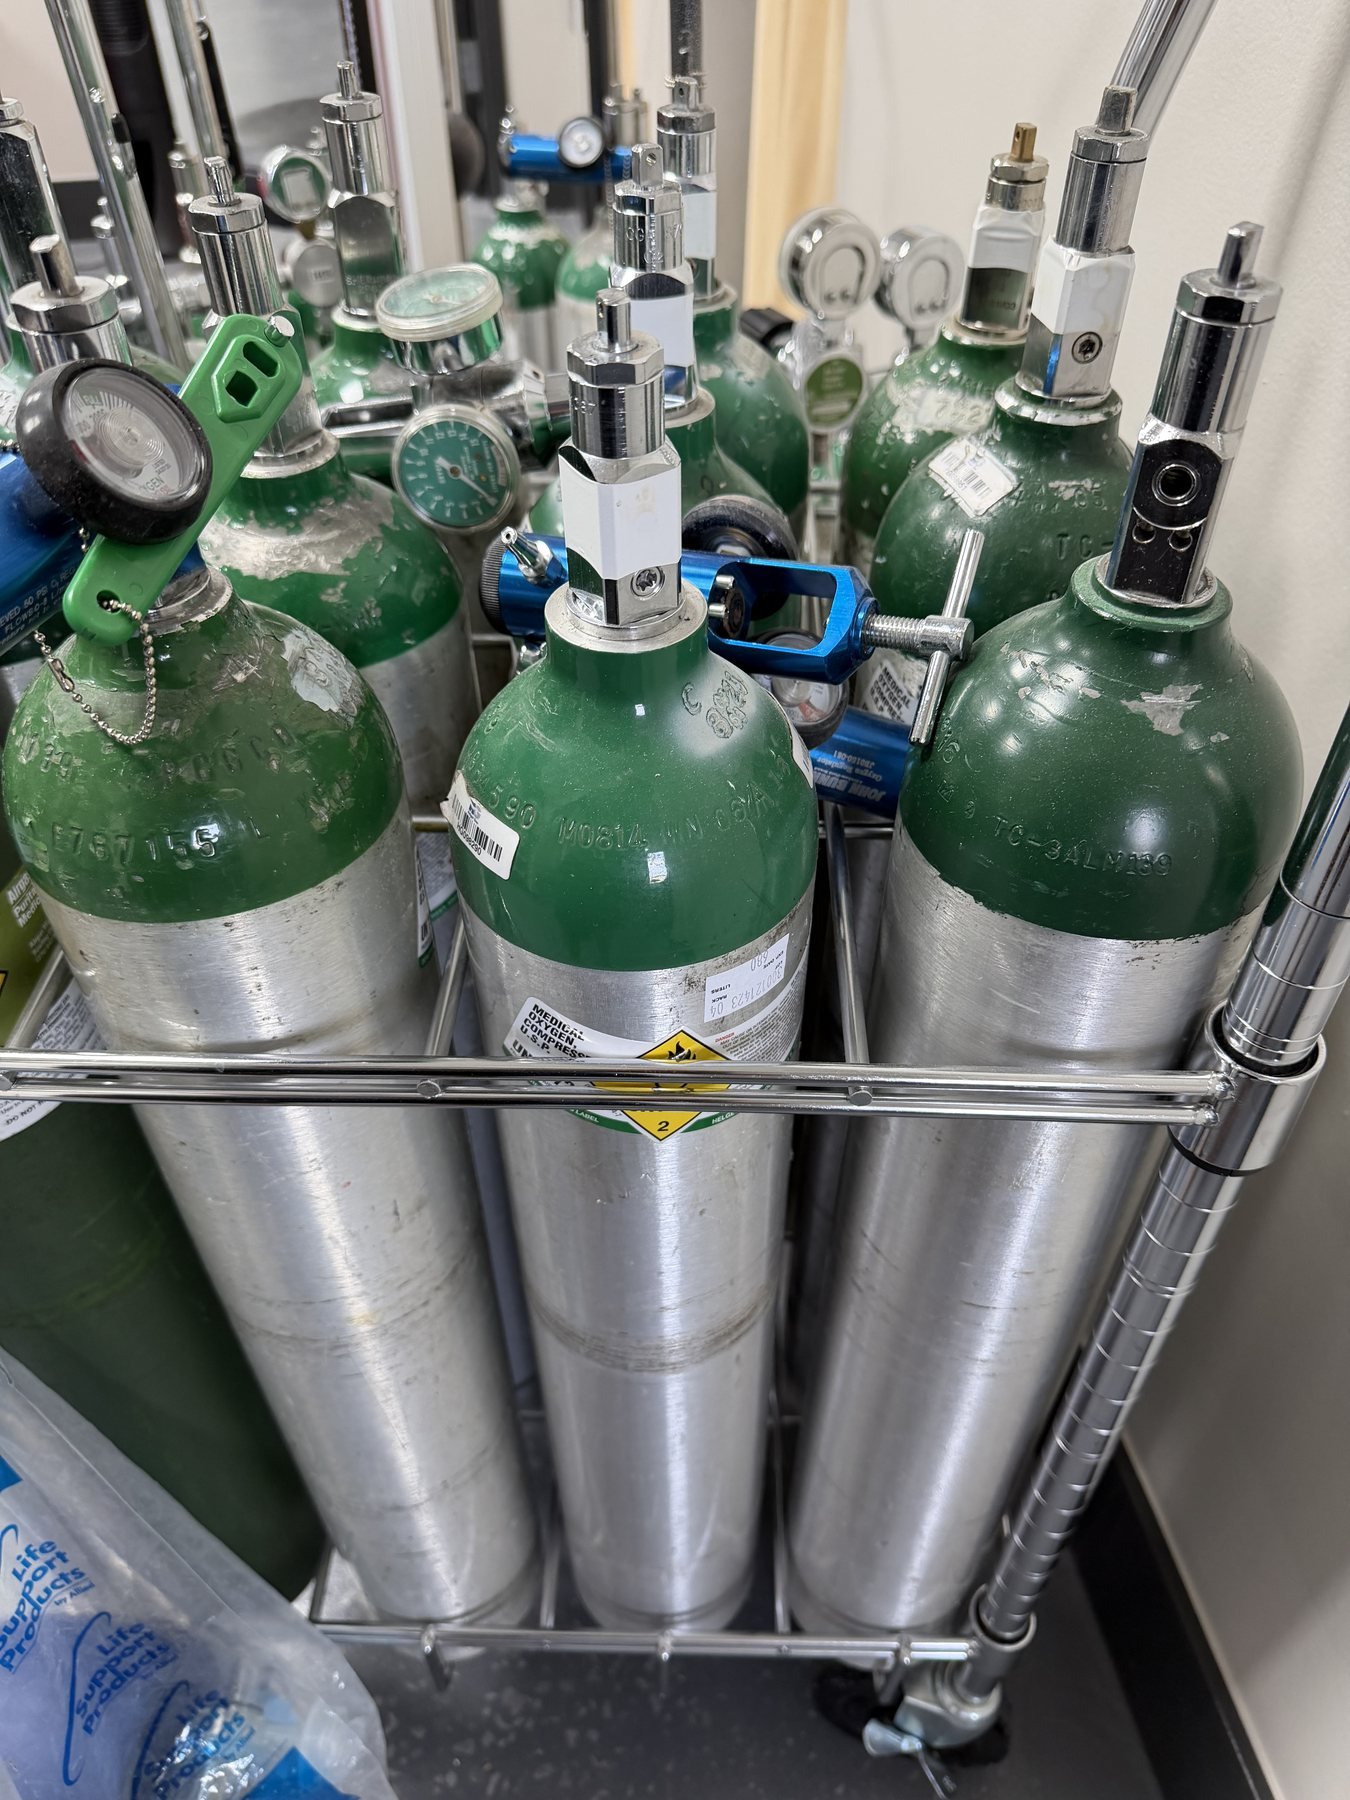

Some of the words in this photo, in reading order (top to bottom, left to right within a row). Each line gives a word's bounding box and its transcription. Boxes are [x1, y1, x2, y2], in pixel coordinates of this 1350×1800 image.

[882, 666, 910, 709] MEDICAL
[711, 983, 731, 994] LITERS
[711, 994, 728, 1004] RACK
[520, 1026, 551, 1055] U.S.P.
[528, 1011, 577, 1049] OXYGEN,
[532, 1003, 585, 1042] MEDICAL
[715, 1032, 735, 1043] DANGER
[656, 1120, 669, 1132] 2
[12, 1540, 57, 1583] Life
[96, 1622, 145, 1656] Life
[76, 1629, 156, 1720] Support
[82, 1643, 170, 1736] Products
